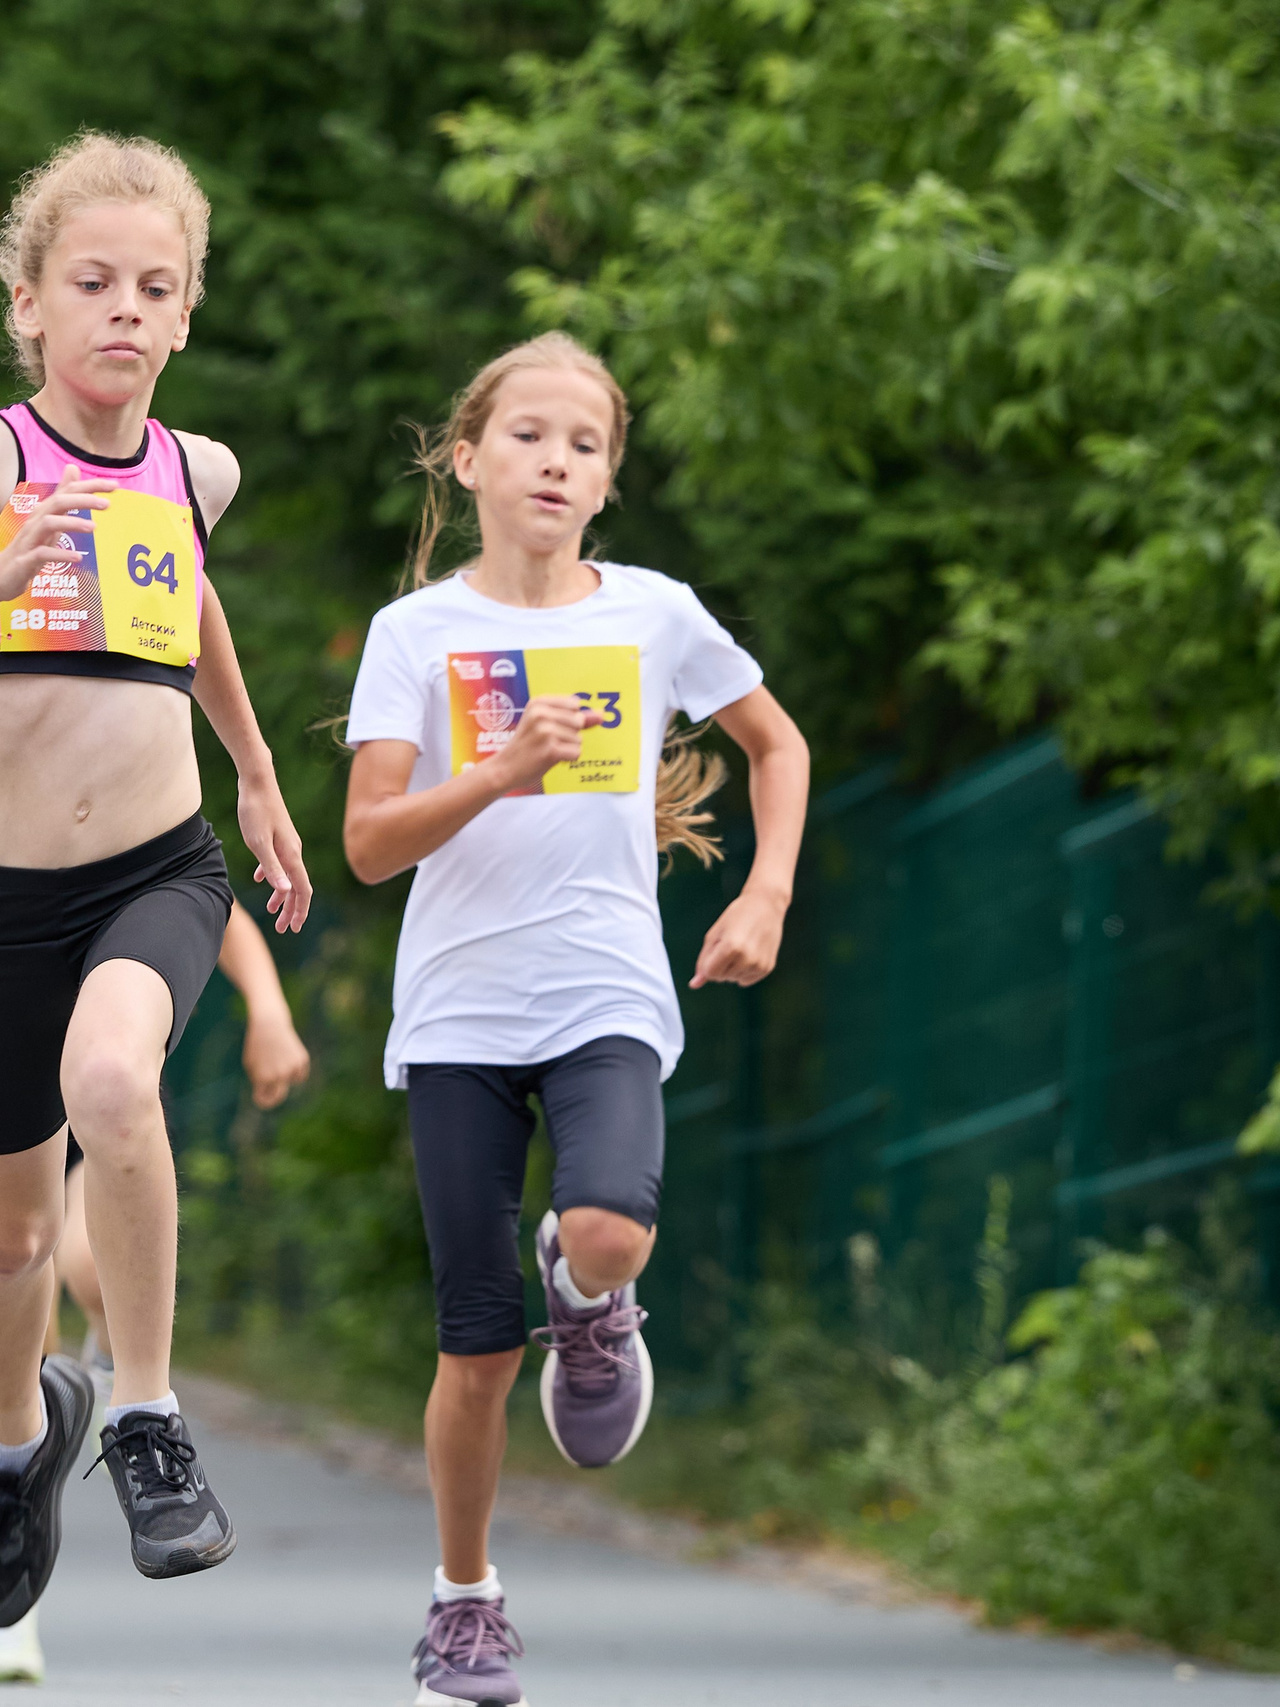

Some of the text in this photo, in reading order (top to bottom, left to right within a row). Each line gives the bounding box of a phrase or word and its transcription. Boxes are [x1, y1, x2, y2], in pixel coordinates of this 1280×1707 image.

[127, 543, 178, 595] 64
[32, 574, 79, 588] АРЕНА
[10, 609, 89, 630] 28 ИЮНЯ
[131, 616, 176, 637] Детский
[138, 637, 168, 651] забег
